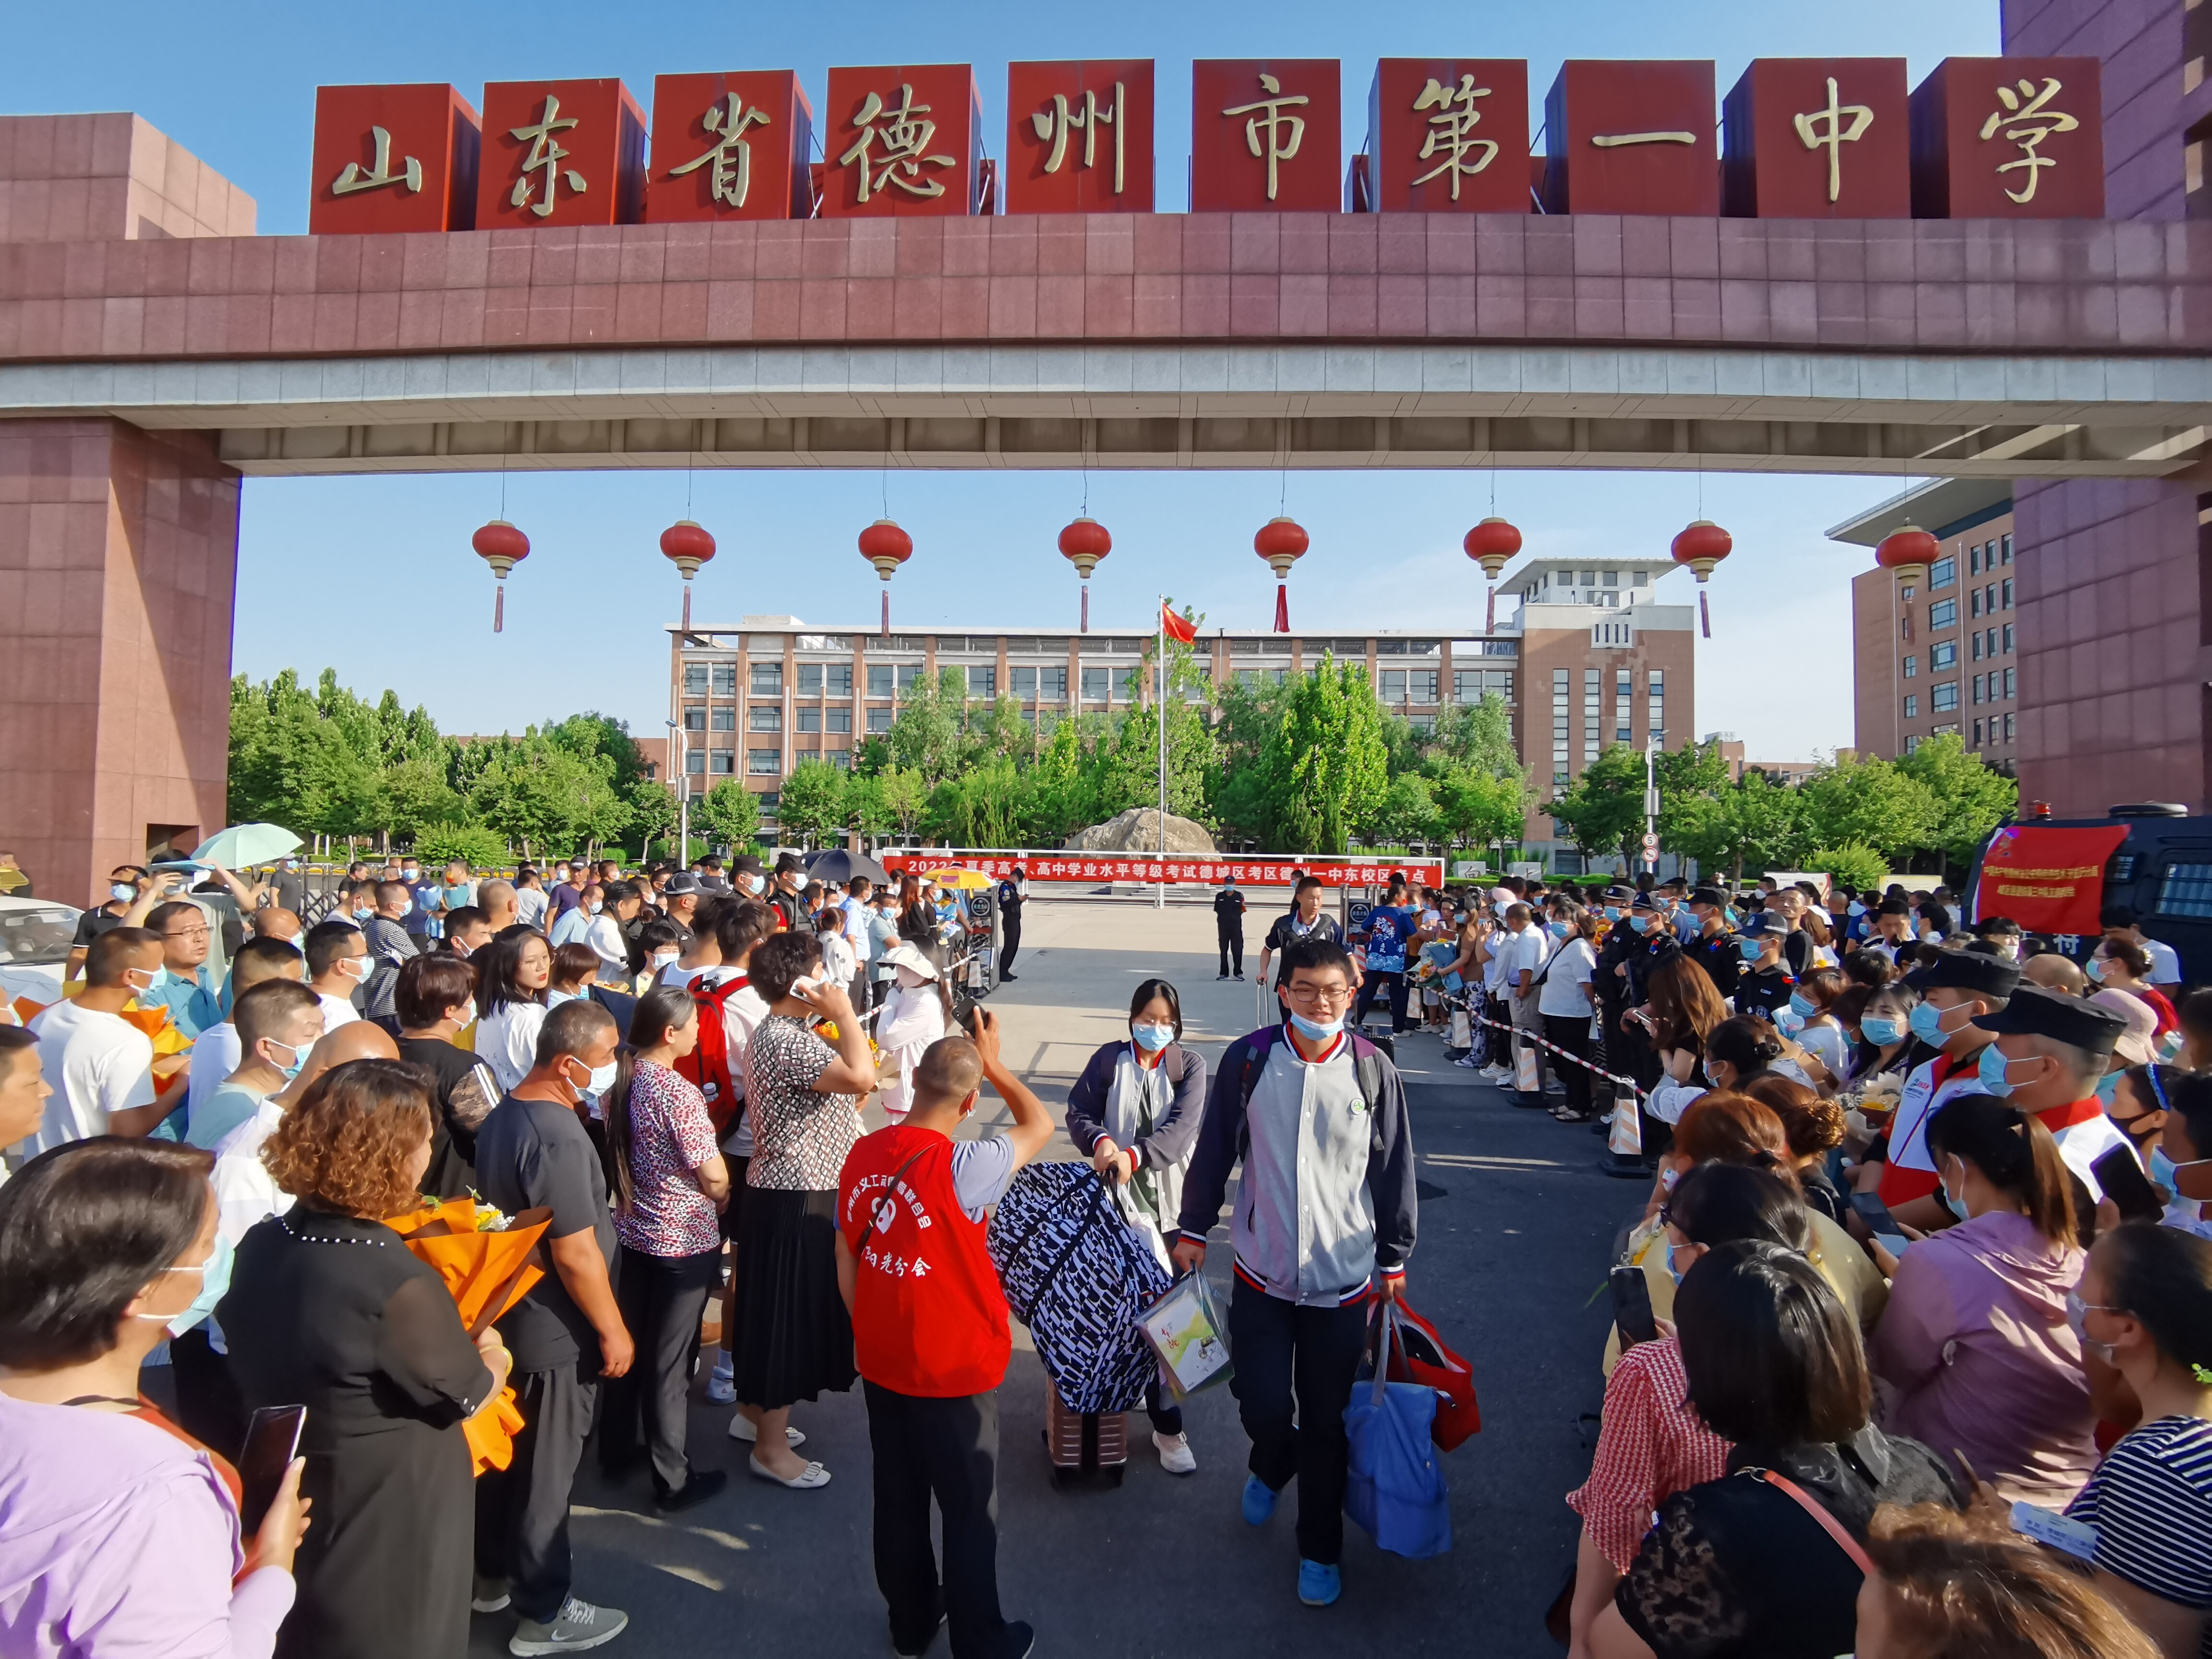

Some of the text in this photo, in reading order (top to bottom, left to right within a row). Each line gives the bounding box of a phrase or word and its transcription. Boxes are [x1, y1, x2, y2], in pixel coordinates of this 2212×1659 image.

[332, 74, 2079, 216] 山东省德州市第一中学
